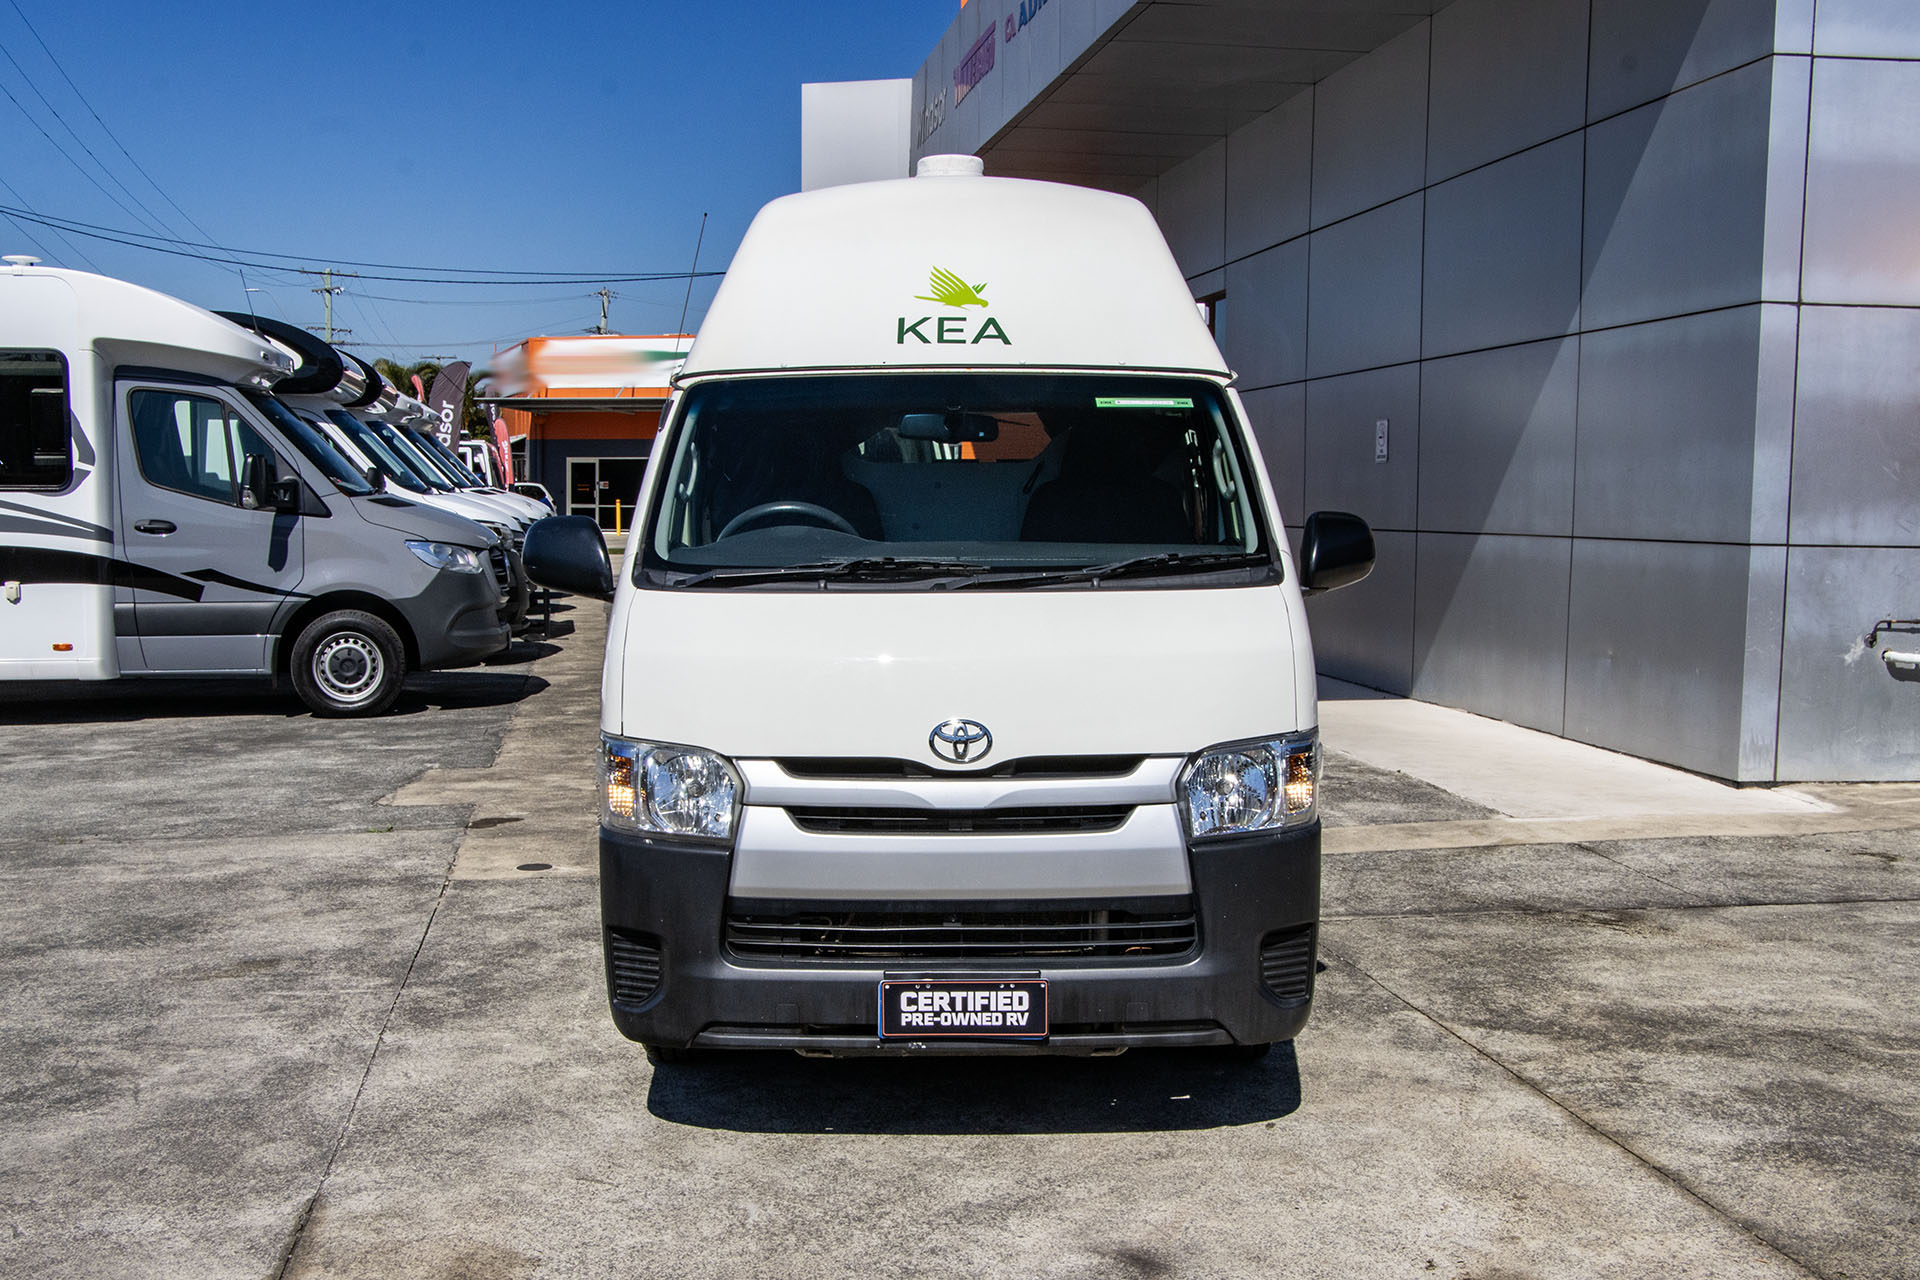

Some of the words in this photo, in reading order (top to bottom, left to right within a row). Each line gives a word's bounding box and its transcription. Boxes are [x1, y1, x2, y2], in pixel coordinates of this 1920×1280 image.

[897, 317, 1012, 345] KEA
[900, 991, 1029, 1012] CERTIFIED
[901, 1012, 1002, 1026] PRE-OWNED
[1006, 1012, 1029, 1026] RV
